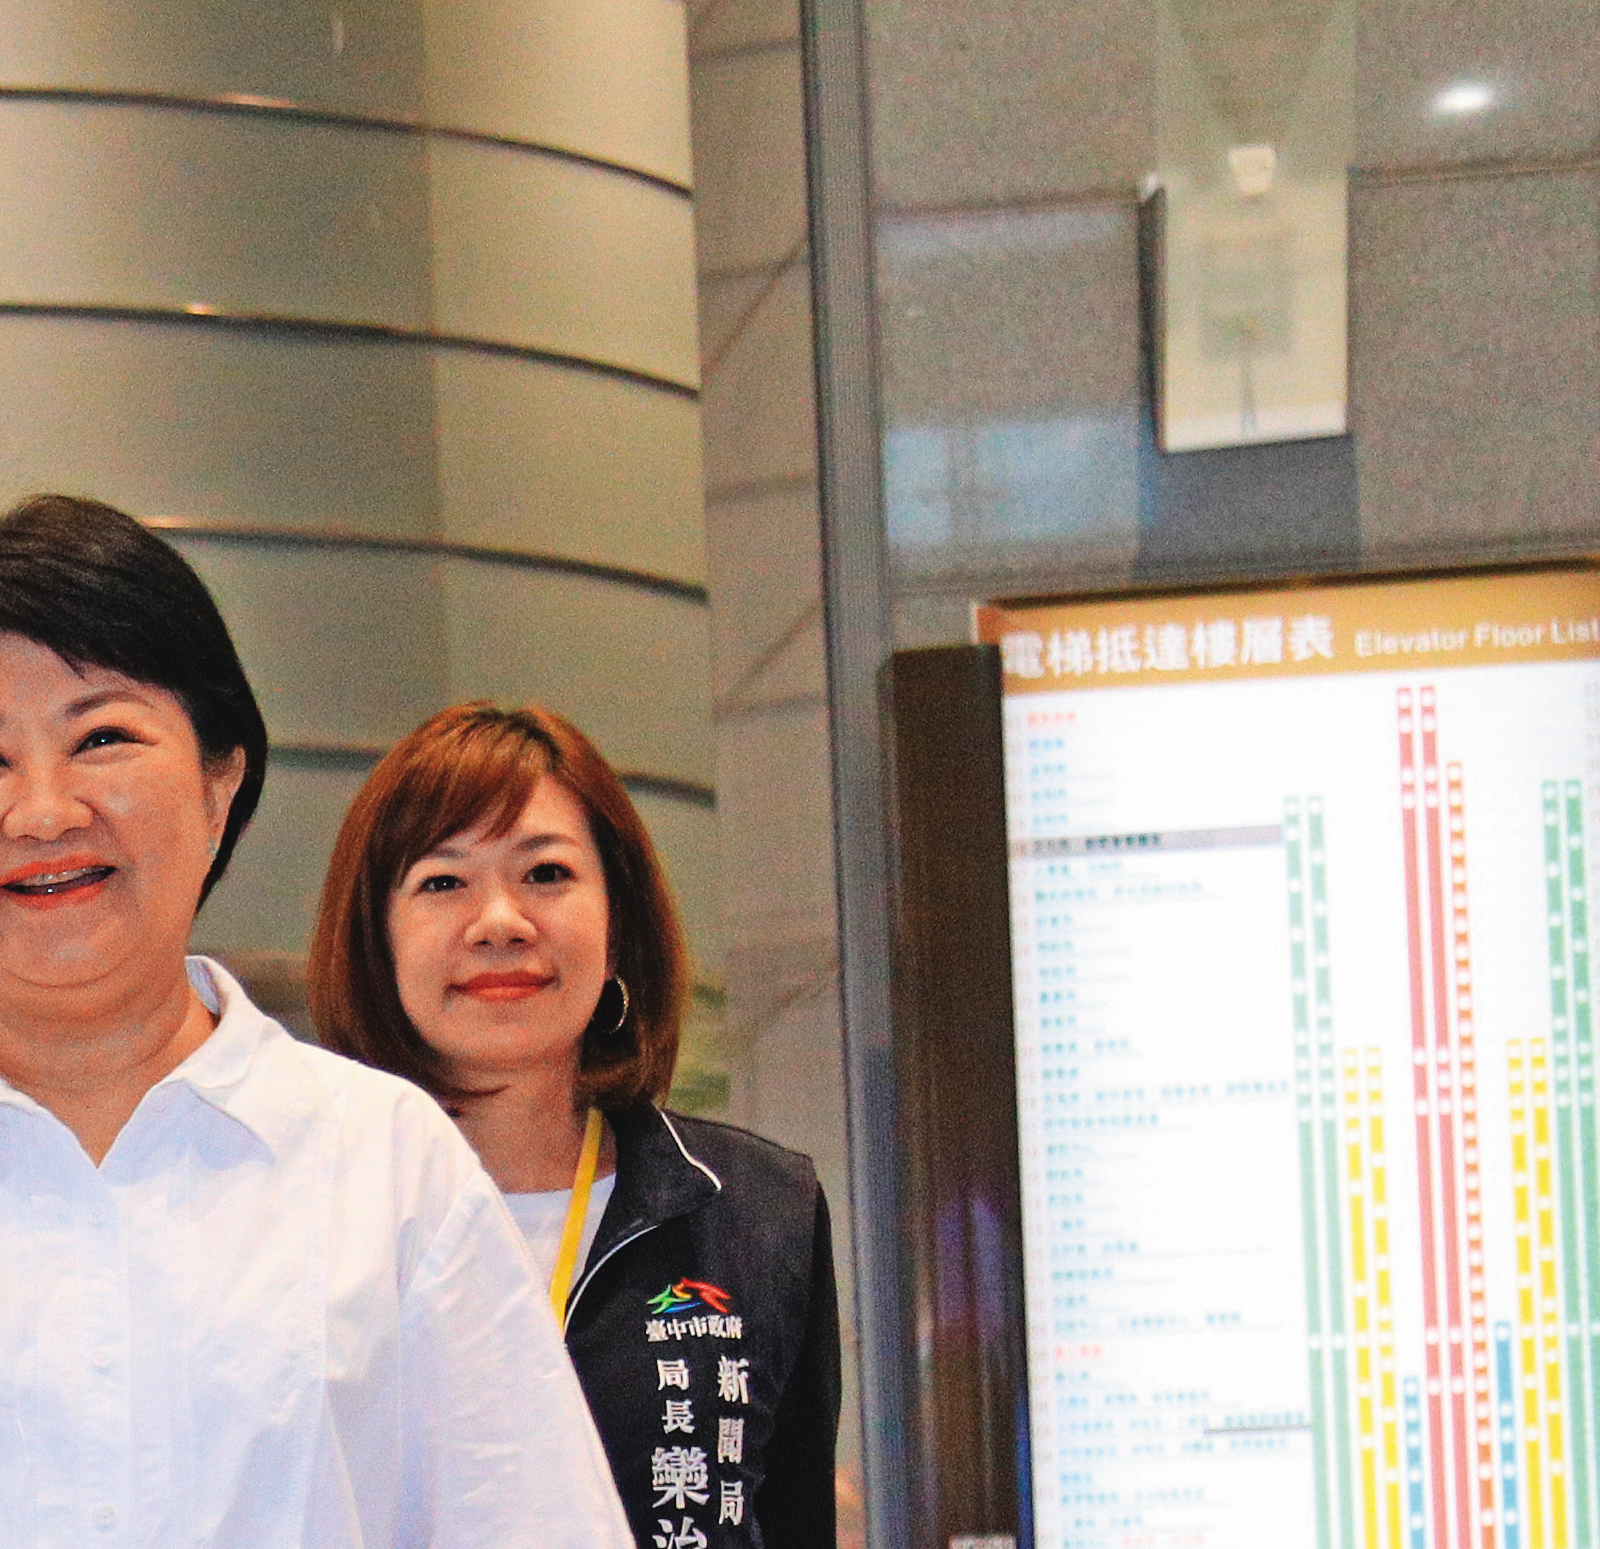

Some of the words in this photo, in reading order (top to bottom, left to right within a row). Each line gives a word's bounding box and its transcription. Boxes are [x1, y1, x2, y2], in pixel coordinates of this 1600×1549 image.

[1001, 614, 1334, 678] 電梯抵達樓層表
[1354, 627, 1467, 657] Elevator
[1474, 620, 1543, 648] Floor
[645, 1314, 743, 1342] 臺中市政府
[657, 1358, 695, 1434] 局長
[717, 1355, 749, 1526] 新聞局
